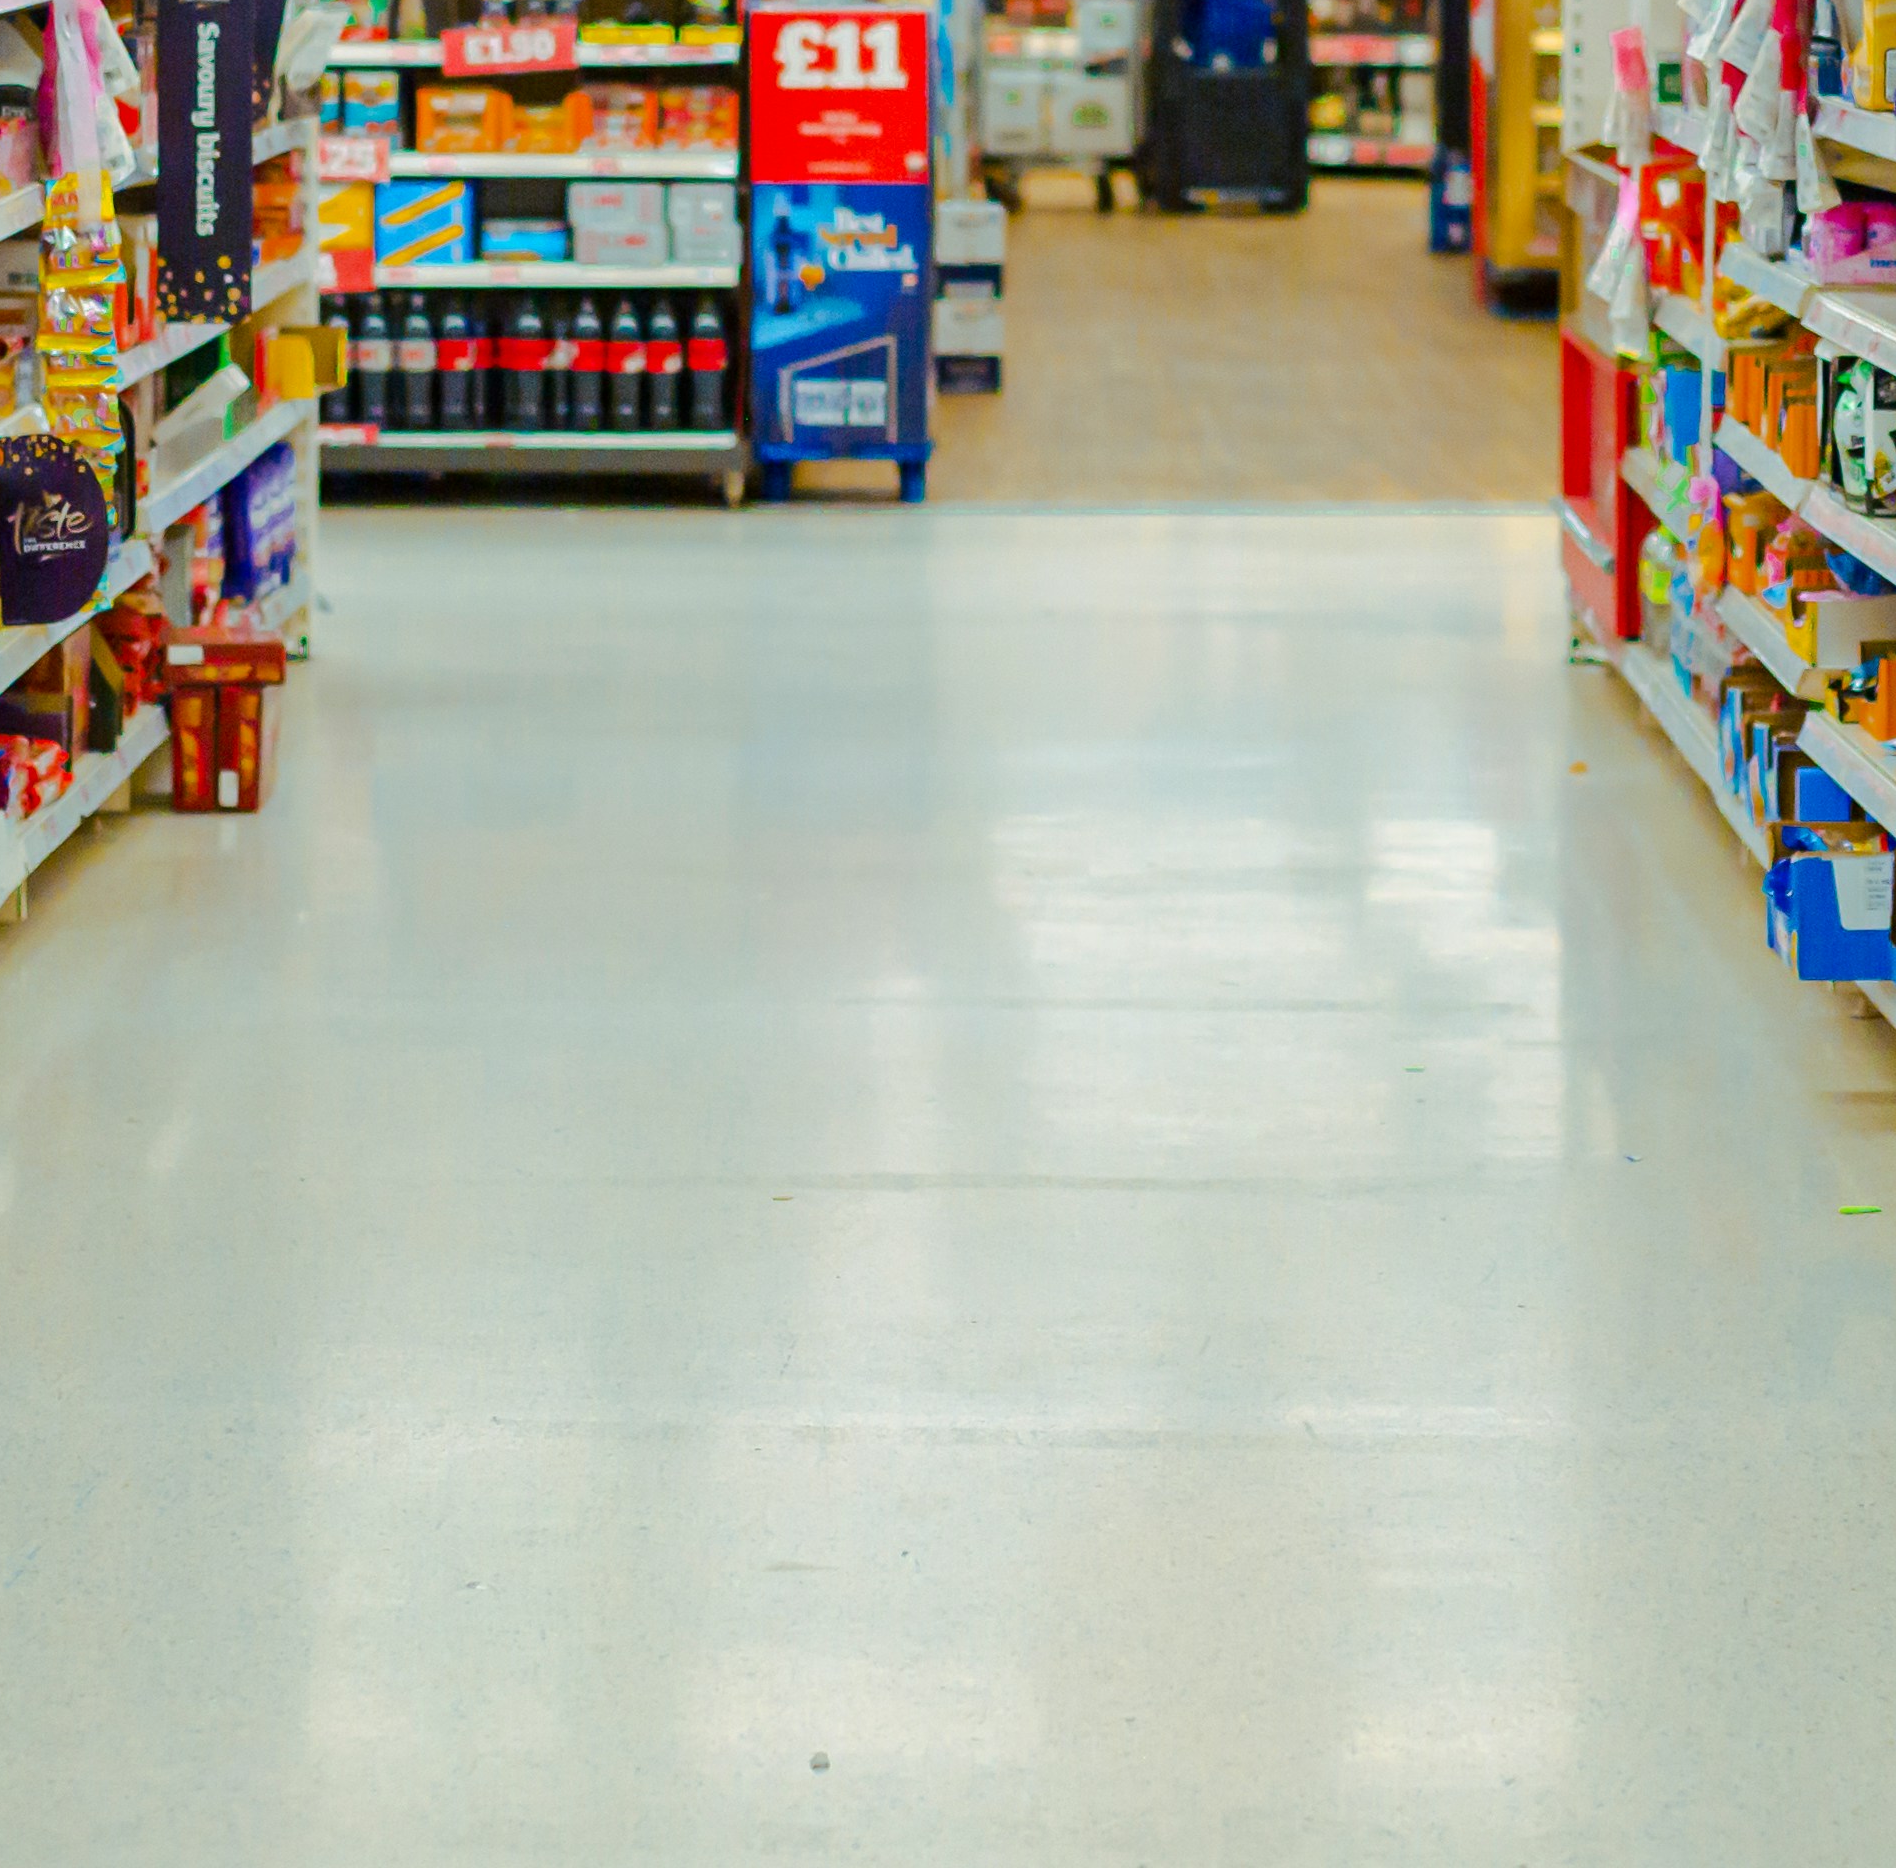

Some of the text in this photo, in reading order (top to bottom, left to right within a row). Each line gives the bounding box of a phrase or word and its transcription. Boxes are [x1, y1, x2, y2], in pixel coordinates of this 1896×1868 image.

[772, 19, 909, 90] £11
[191, 22, 221, 237] Savoury biscuits
